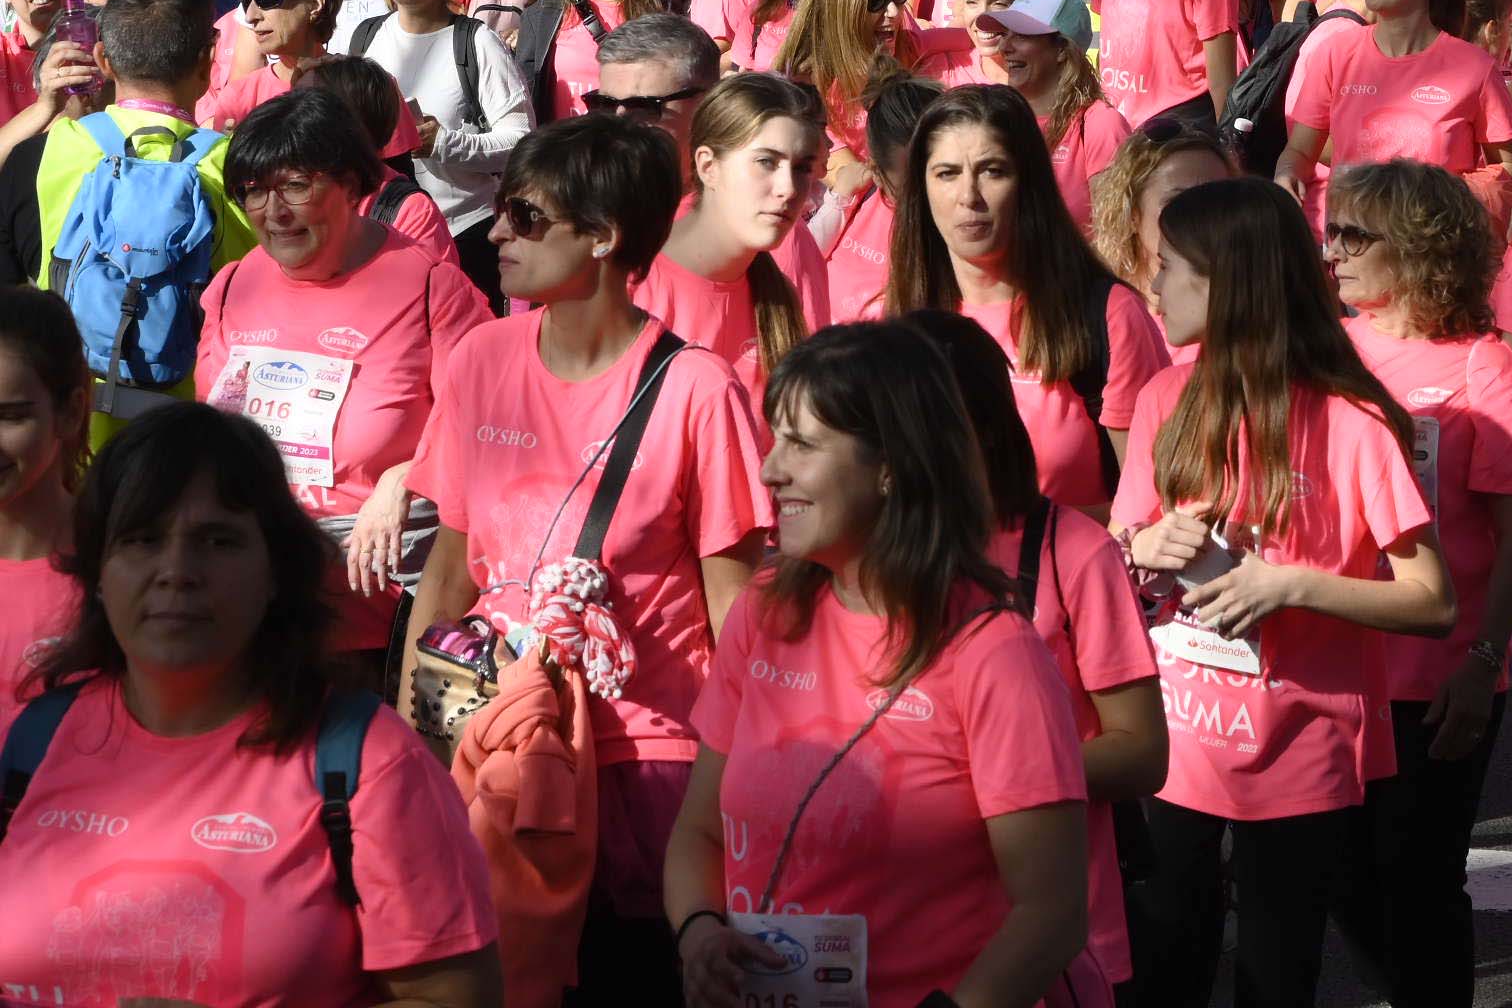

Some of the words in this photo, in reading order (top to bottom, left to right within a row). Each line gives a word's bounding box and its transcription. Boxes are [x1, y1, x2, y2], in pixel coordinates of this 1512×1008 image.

[841, 235, 885, 265] OYSHO
[230, 328, 277, 343] OYSHO
[255, 369, 304, 386] ASTURIANA
[314, 371, 343, 385] SUMA
[248, 397, 292, 420] 016
[1199, 640, 1251, 659] Santander
[750, 659, 817, 691] OYSHO
[1236, 742, 1259, 754] 2023
[37, 809, 130, 838] OYSHO
[196, 823, 269, 847] ASTURIANA
[814, 943, 852, 954] SUMA
